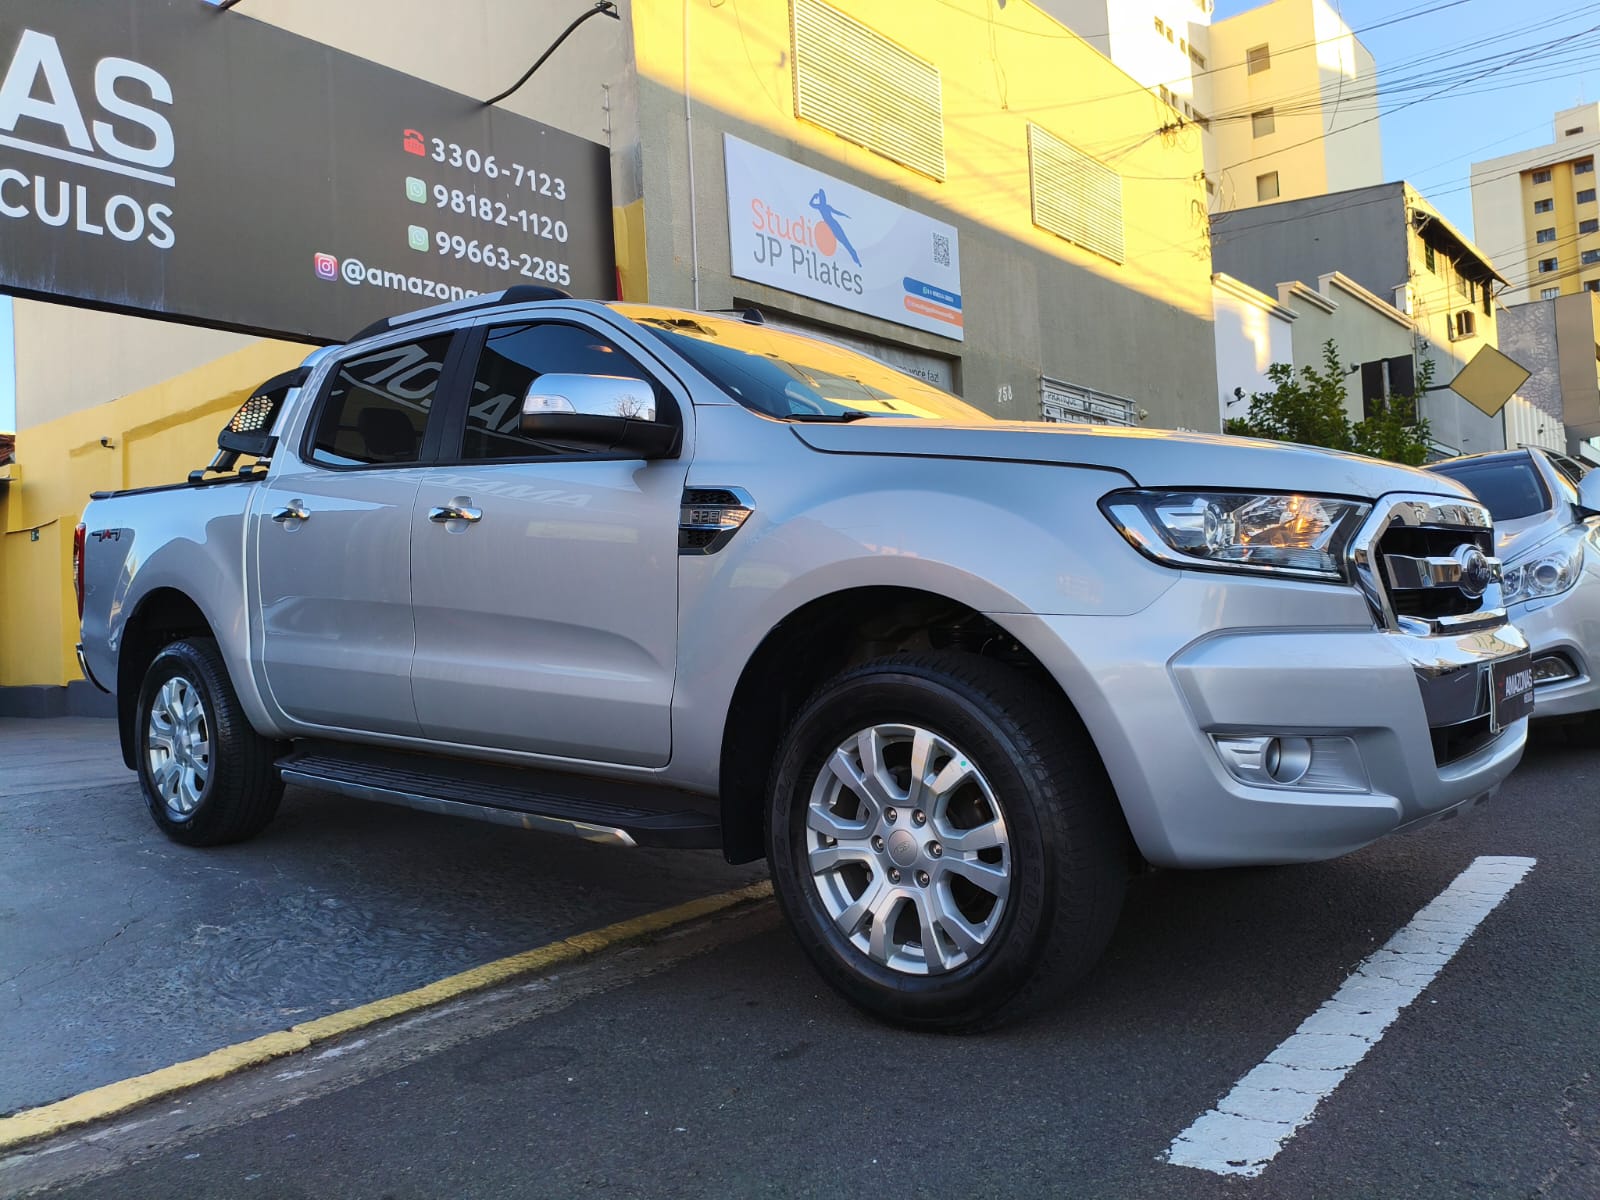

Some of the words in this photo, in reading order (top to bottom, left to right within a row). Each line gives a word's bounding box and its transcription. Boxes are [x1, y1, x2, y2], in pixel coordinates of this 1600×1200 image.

[431, 137, 567, 201] 3306-7123
[433, 184, 568, 243] 98182-1120
[435, 231, 571, 286] 99663-2285
[753, 232, 783, 267] JP
[790, 243, 863, 296] Pilates
